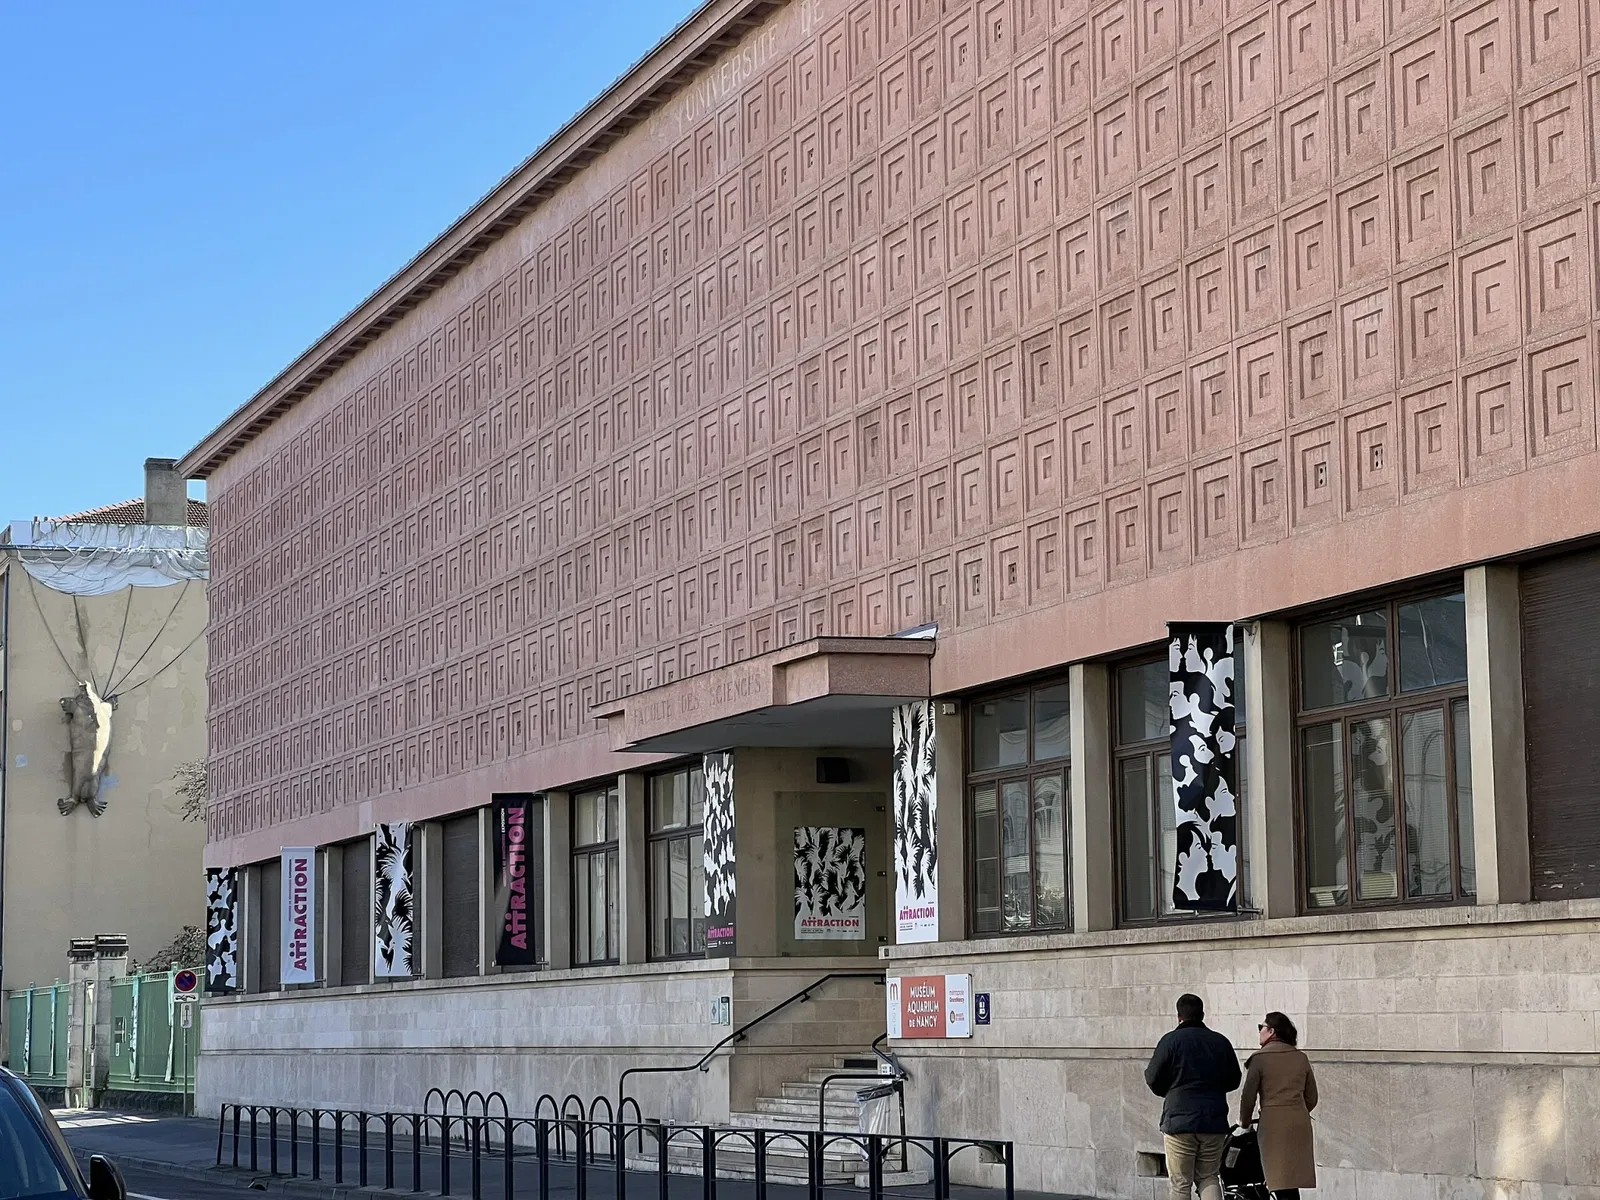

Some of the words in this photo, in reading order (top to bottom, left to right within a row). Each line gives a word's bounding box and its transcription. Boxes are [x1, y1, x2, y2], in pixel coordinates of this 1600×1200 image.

[680, 692, 701, 714] DES
[709, 673, 762, 707] SCIENCES
[910, 981, 936, 998] MUSÉUM
[907, 1000, 940, 1015] AQUARIUM
[909, 1019, 916, 1028] DE
[916, 1015, 938, 1028] NANCY
